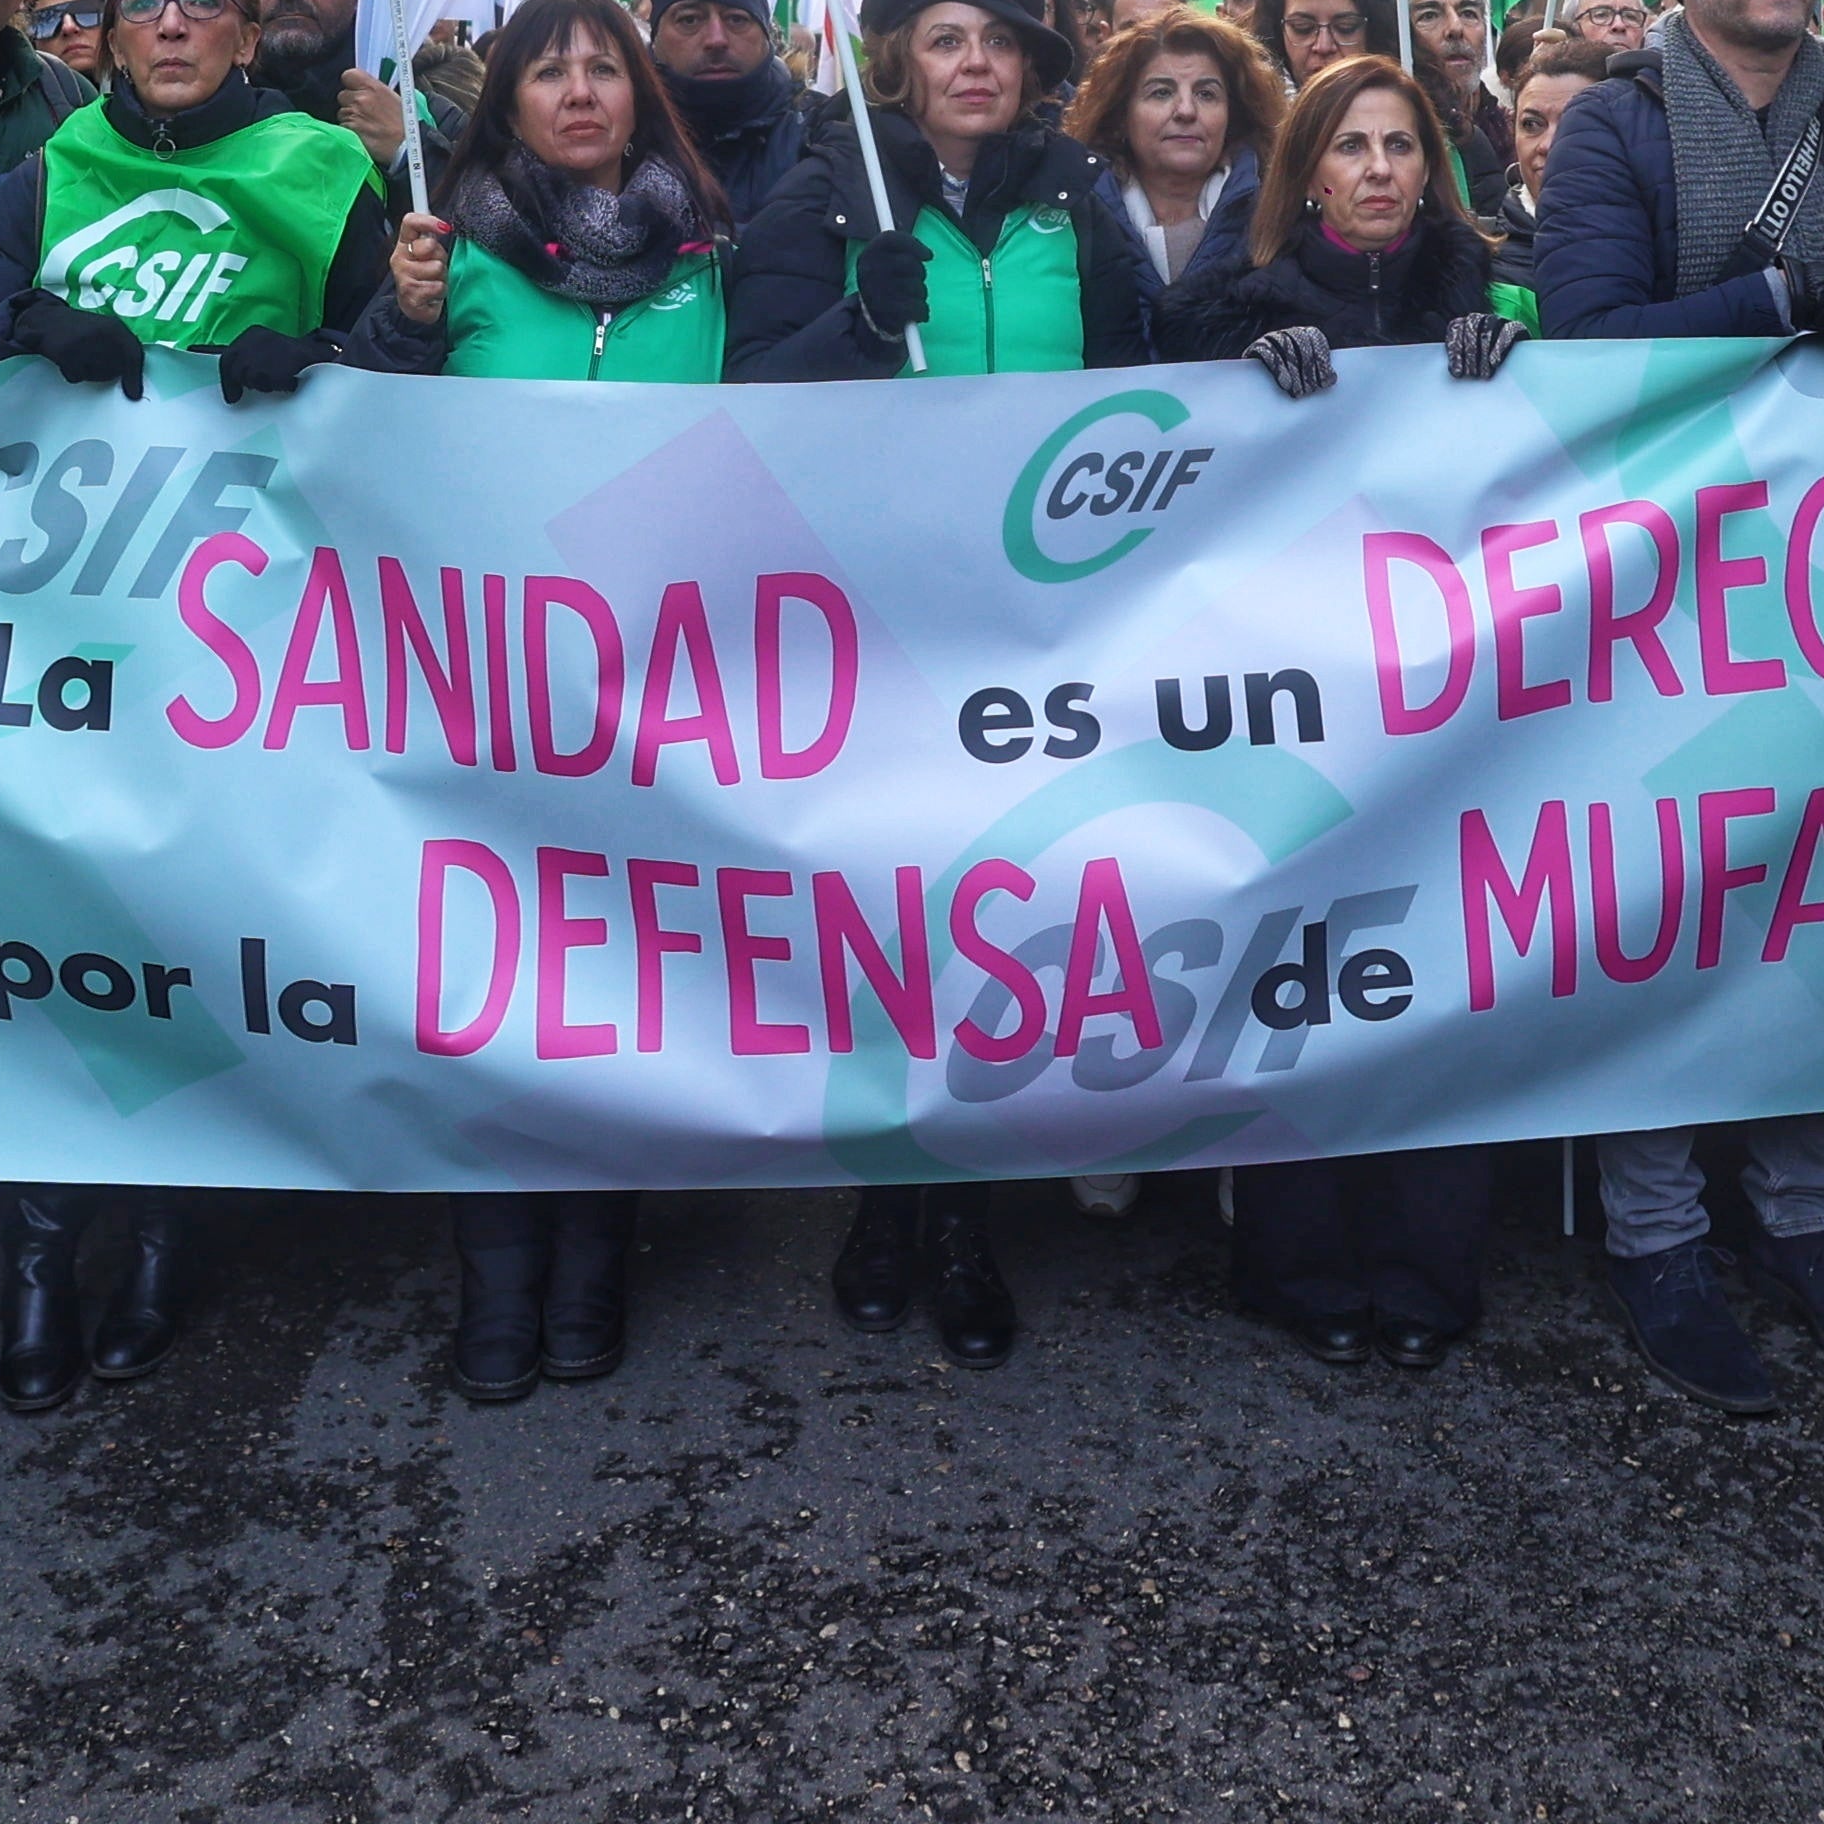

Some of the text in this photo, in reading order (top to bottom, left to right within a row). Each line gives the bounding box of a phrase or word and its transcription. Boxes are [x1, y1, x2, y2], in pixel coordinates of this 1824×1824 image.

[75, 240, 247, 322] CSIF
[665, 288, 697, 304] SIF
[1045, 445, 1214, 523] CSIF
[164, 530, 860, 788] SANIDAD
[956, 679, 1102, 763] es
[1154, 664, 1326, 752] un
[240, 937, 359, 1047] la
[413, 837, 1165, 1064] DEFENSA
[1250, 920, 1414, 1031] de
